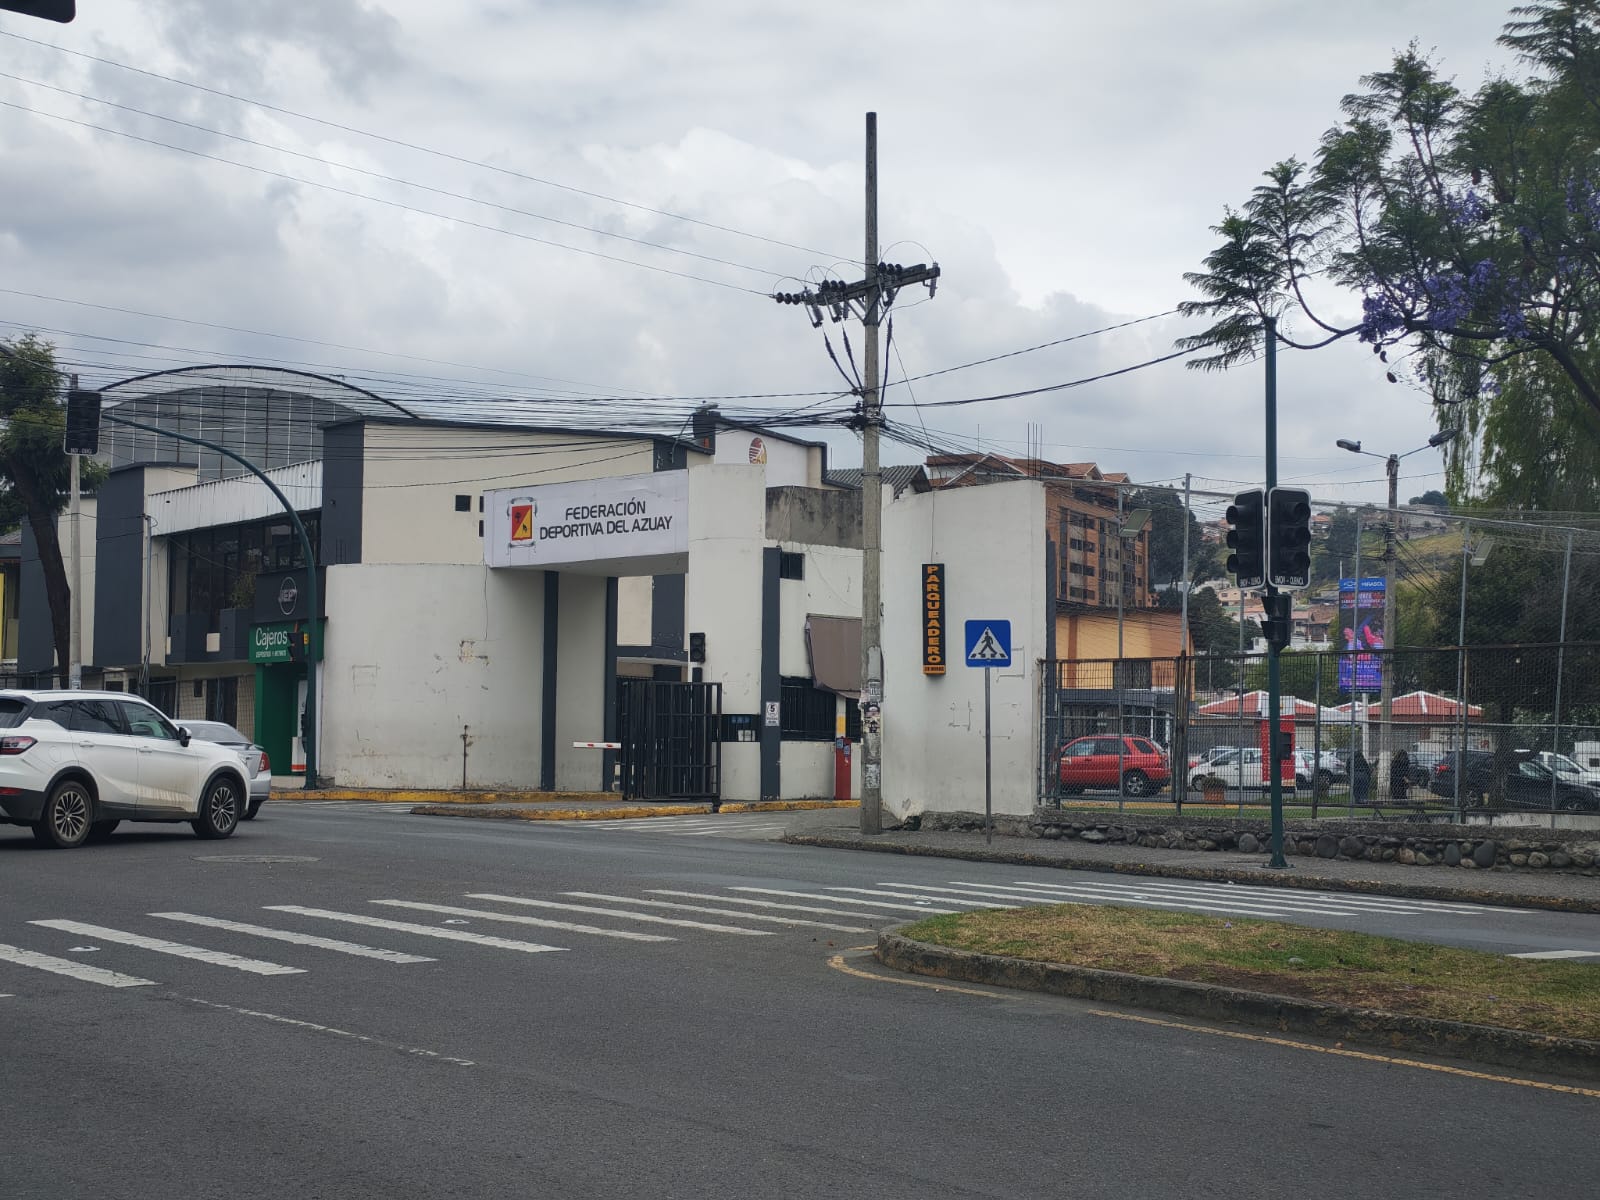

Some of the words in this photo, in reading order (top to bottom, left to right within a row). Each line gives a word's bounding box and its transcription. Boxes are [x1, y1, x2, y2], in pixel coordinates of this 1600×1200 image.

[565, 497, 646, 520] FEDERACIÓN
[539, 522, 604, 540] DEPORTIVA
[606, 519, 629, 535] DEL
[631, 516, 672, 532] AZUAY
[926, 565, 941, 663] PARQUEADERO
[256, 627, 288, 650] Cajeros
[770, 704, 776, 712] 5
